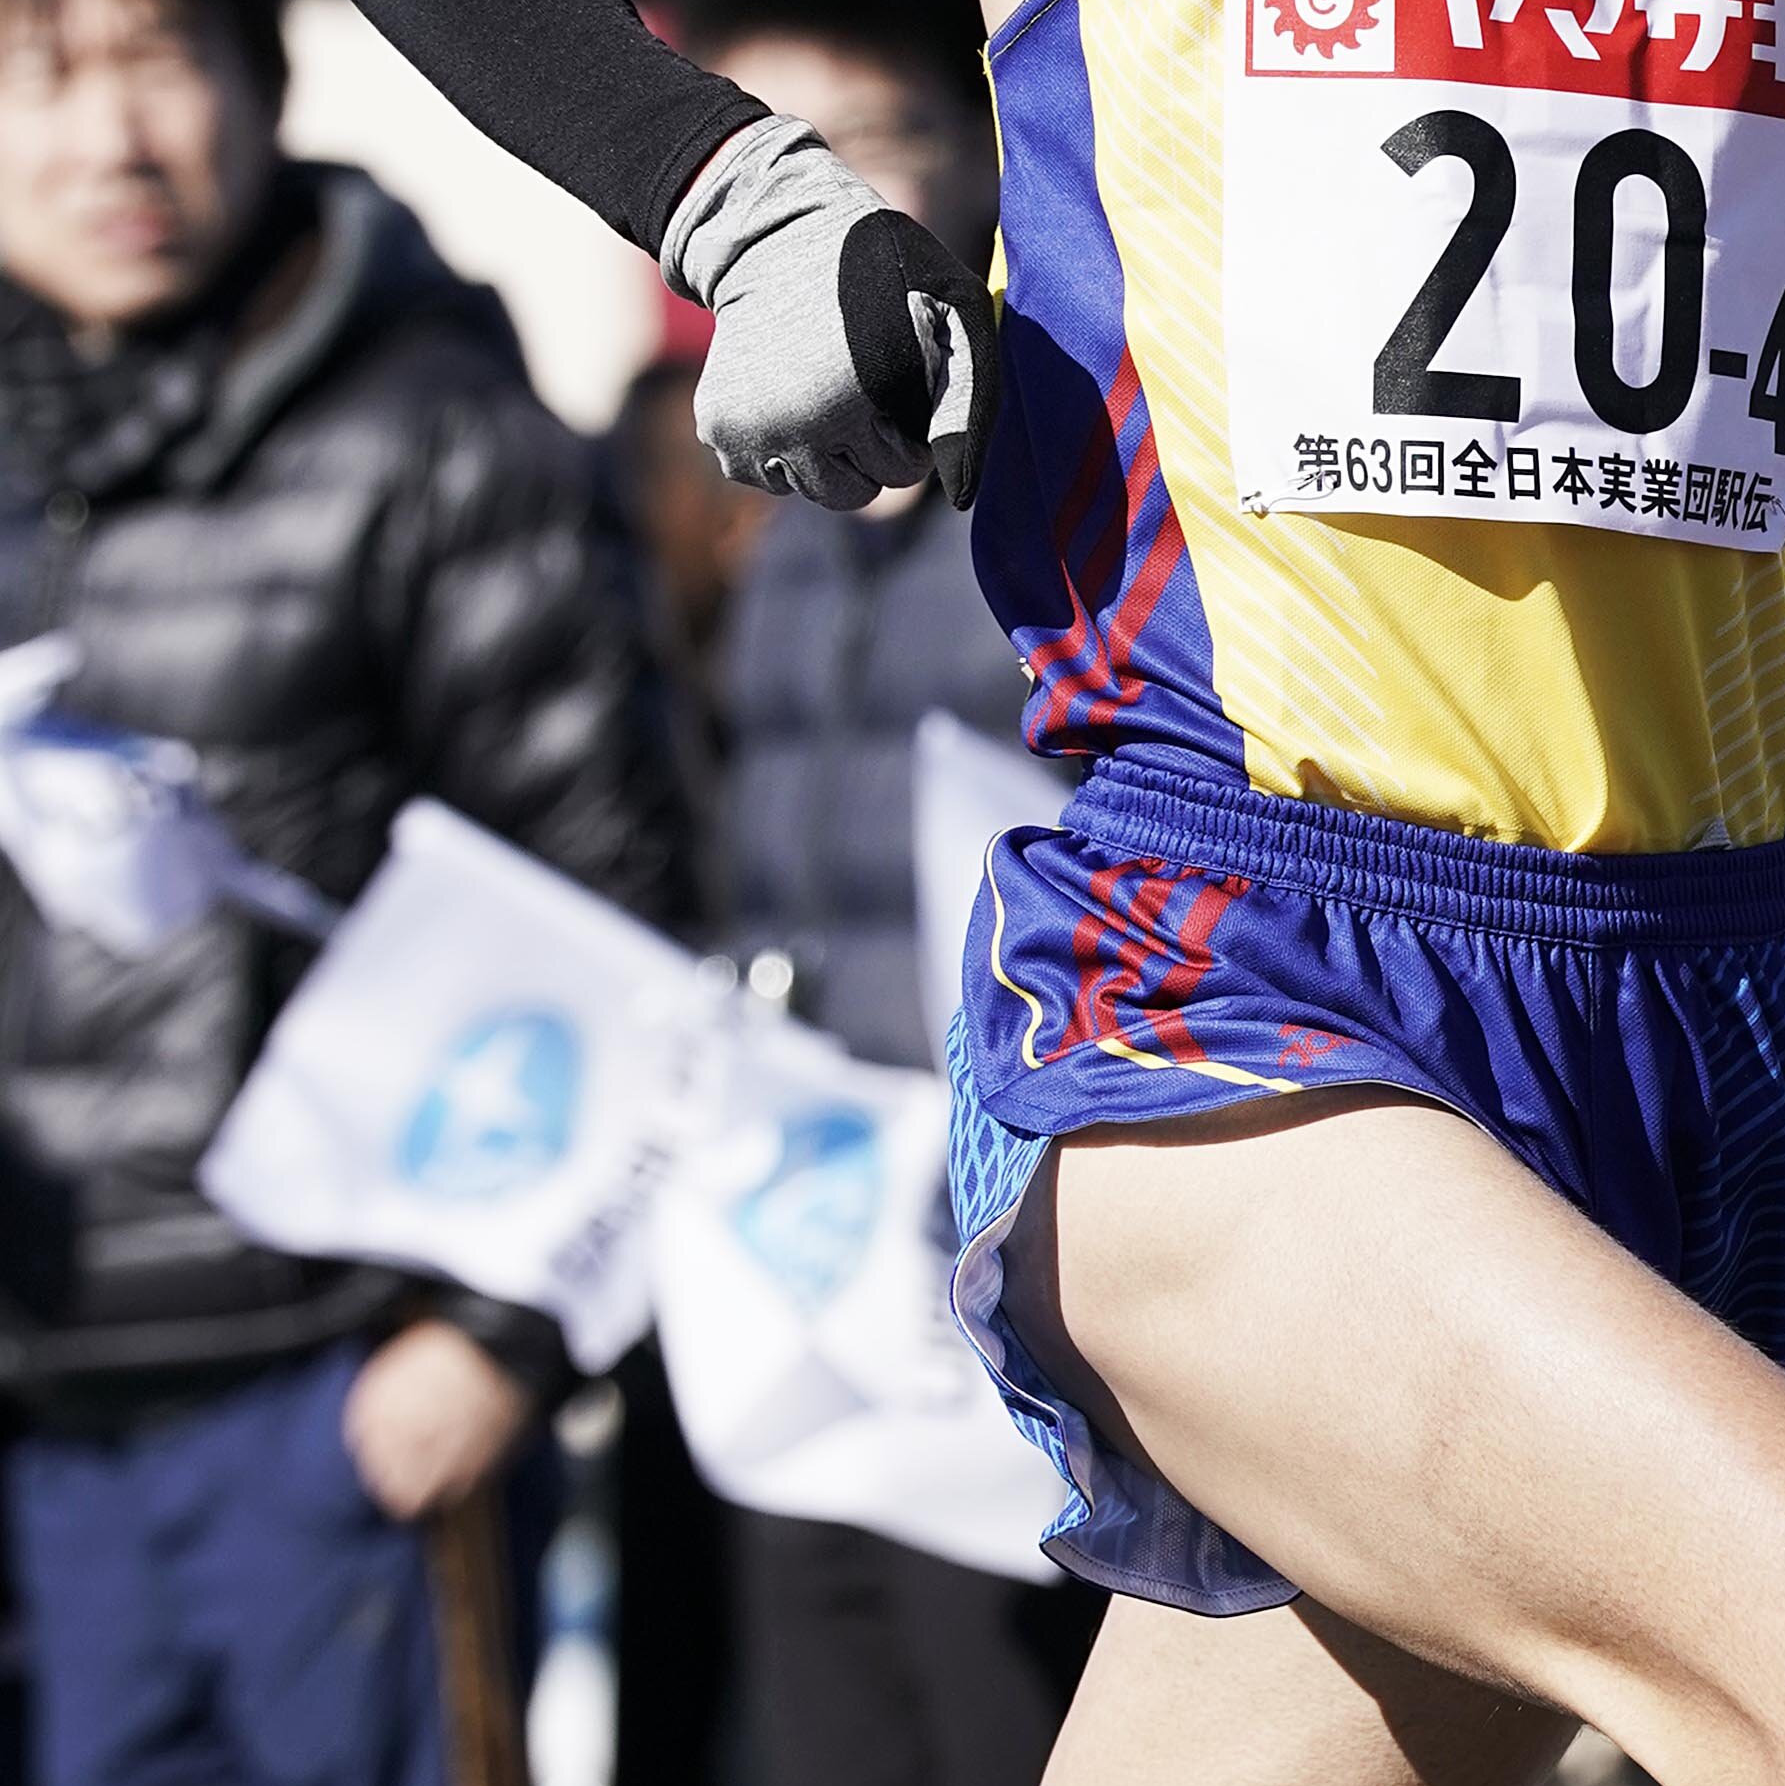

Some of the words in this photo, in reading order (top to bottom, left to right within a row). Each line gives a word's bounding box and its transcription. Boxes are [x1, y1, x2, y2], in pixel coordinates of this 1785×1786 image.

[1293, 433, 1775, 533] 第63回全日本実業団駅伝
